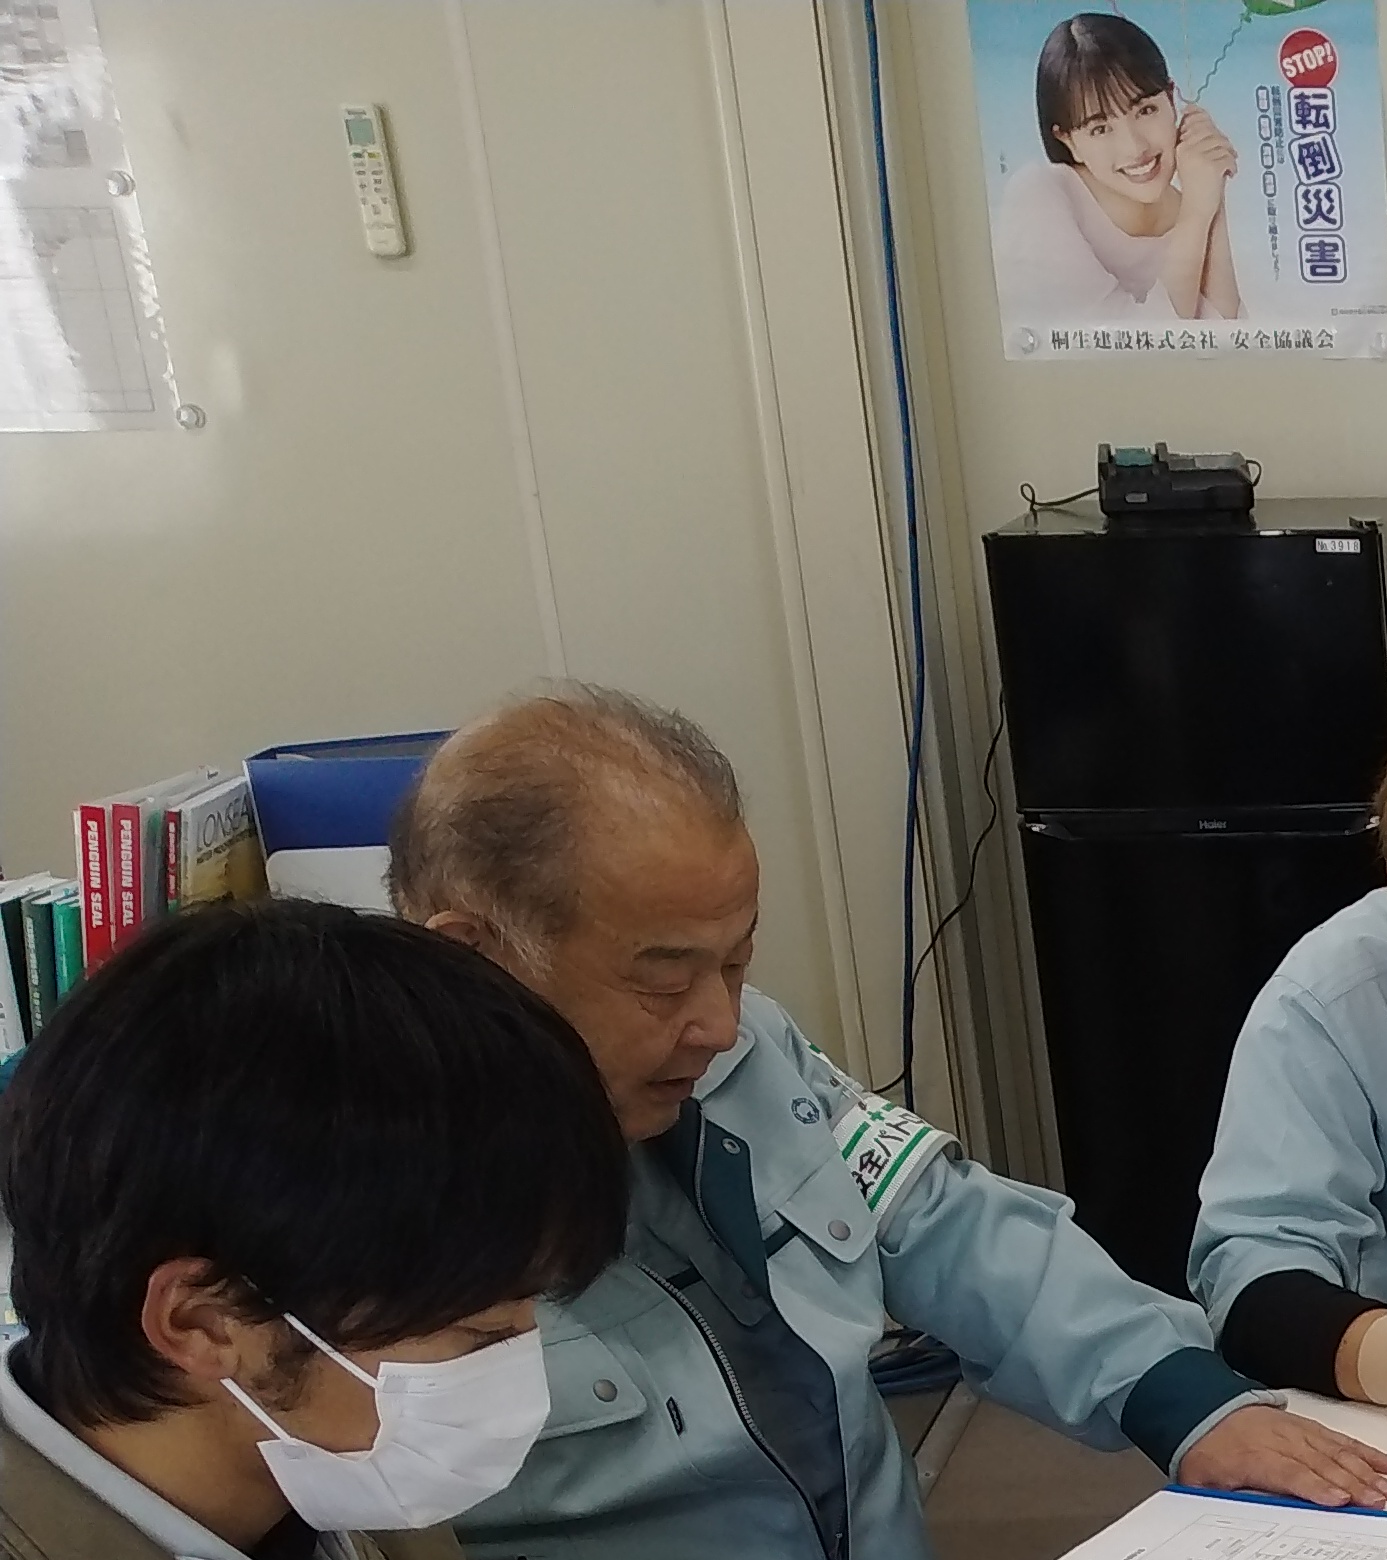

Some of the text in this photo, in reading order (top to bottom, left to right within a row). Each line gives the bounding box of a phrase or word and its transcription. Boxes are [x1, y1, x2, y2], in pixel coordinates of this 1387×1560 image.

[1282, 43, 1335, 80] STOP!
[1293, 91, 1341, 277] 転倒災害
[1051, 328, 1334, 350] 桐生建設株式会社 安全協議会
[1199, 819, 1227, 829] Haier
[87, 820, 103, 929] PENGUIN SEAL
[120, 819, 134, 927] PENGUIN SEAL
